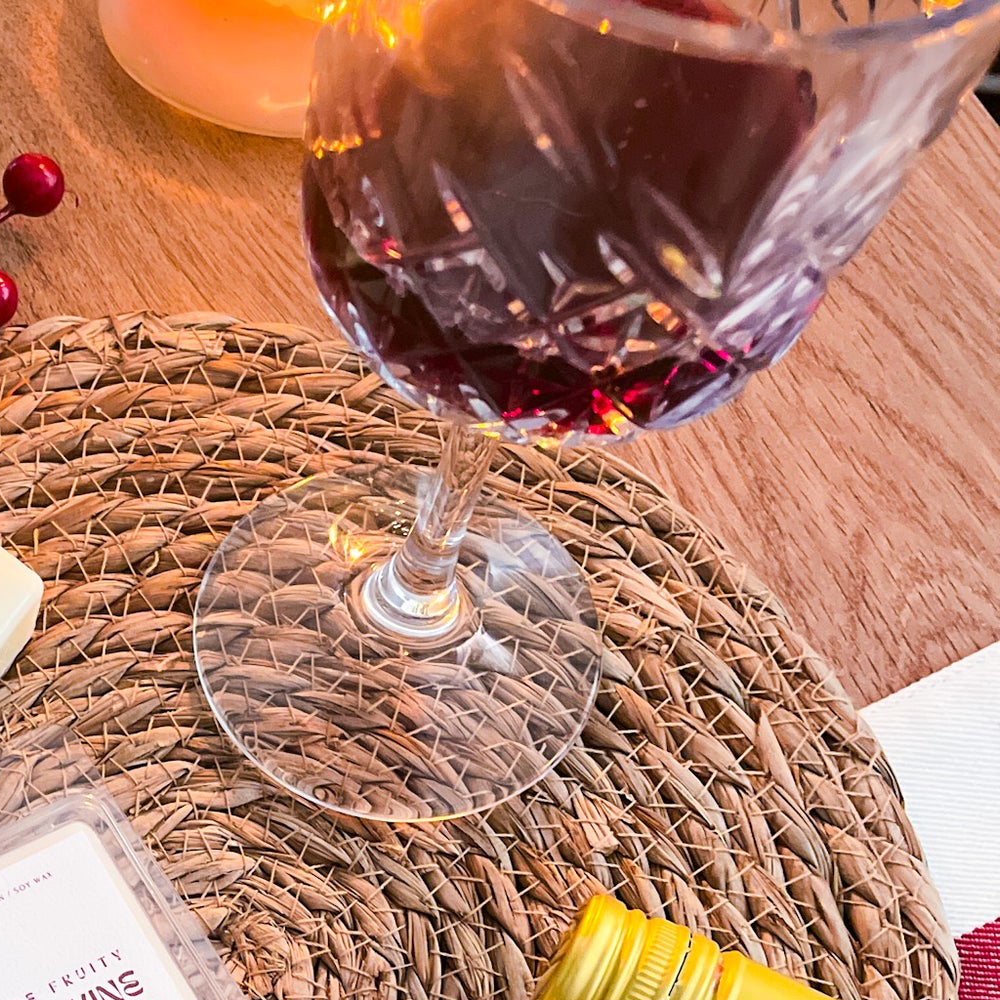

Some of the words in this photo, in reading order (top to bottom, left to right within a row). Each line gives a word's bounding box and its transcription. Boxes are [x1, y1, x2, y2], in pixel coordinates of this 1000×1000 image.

[13, 881, 31, 894] SOY
[33, 871, 53, 884] WAX
[48, 949, 123, 994] FRUITY
